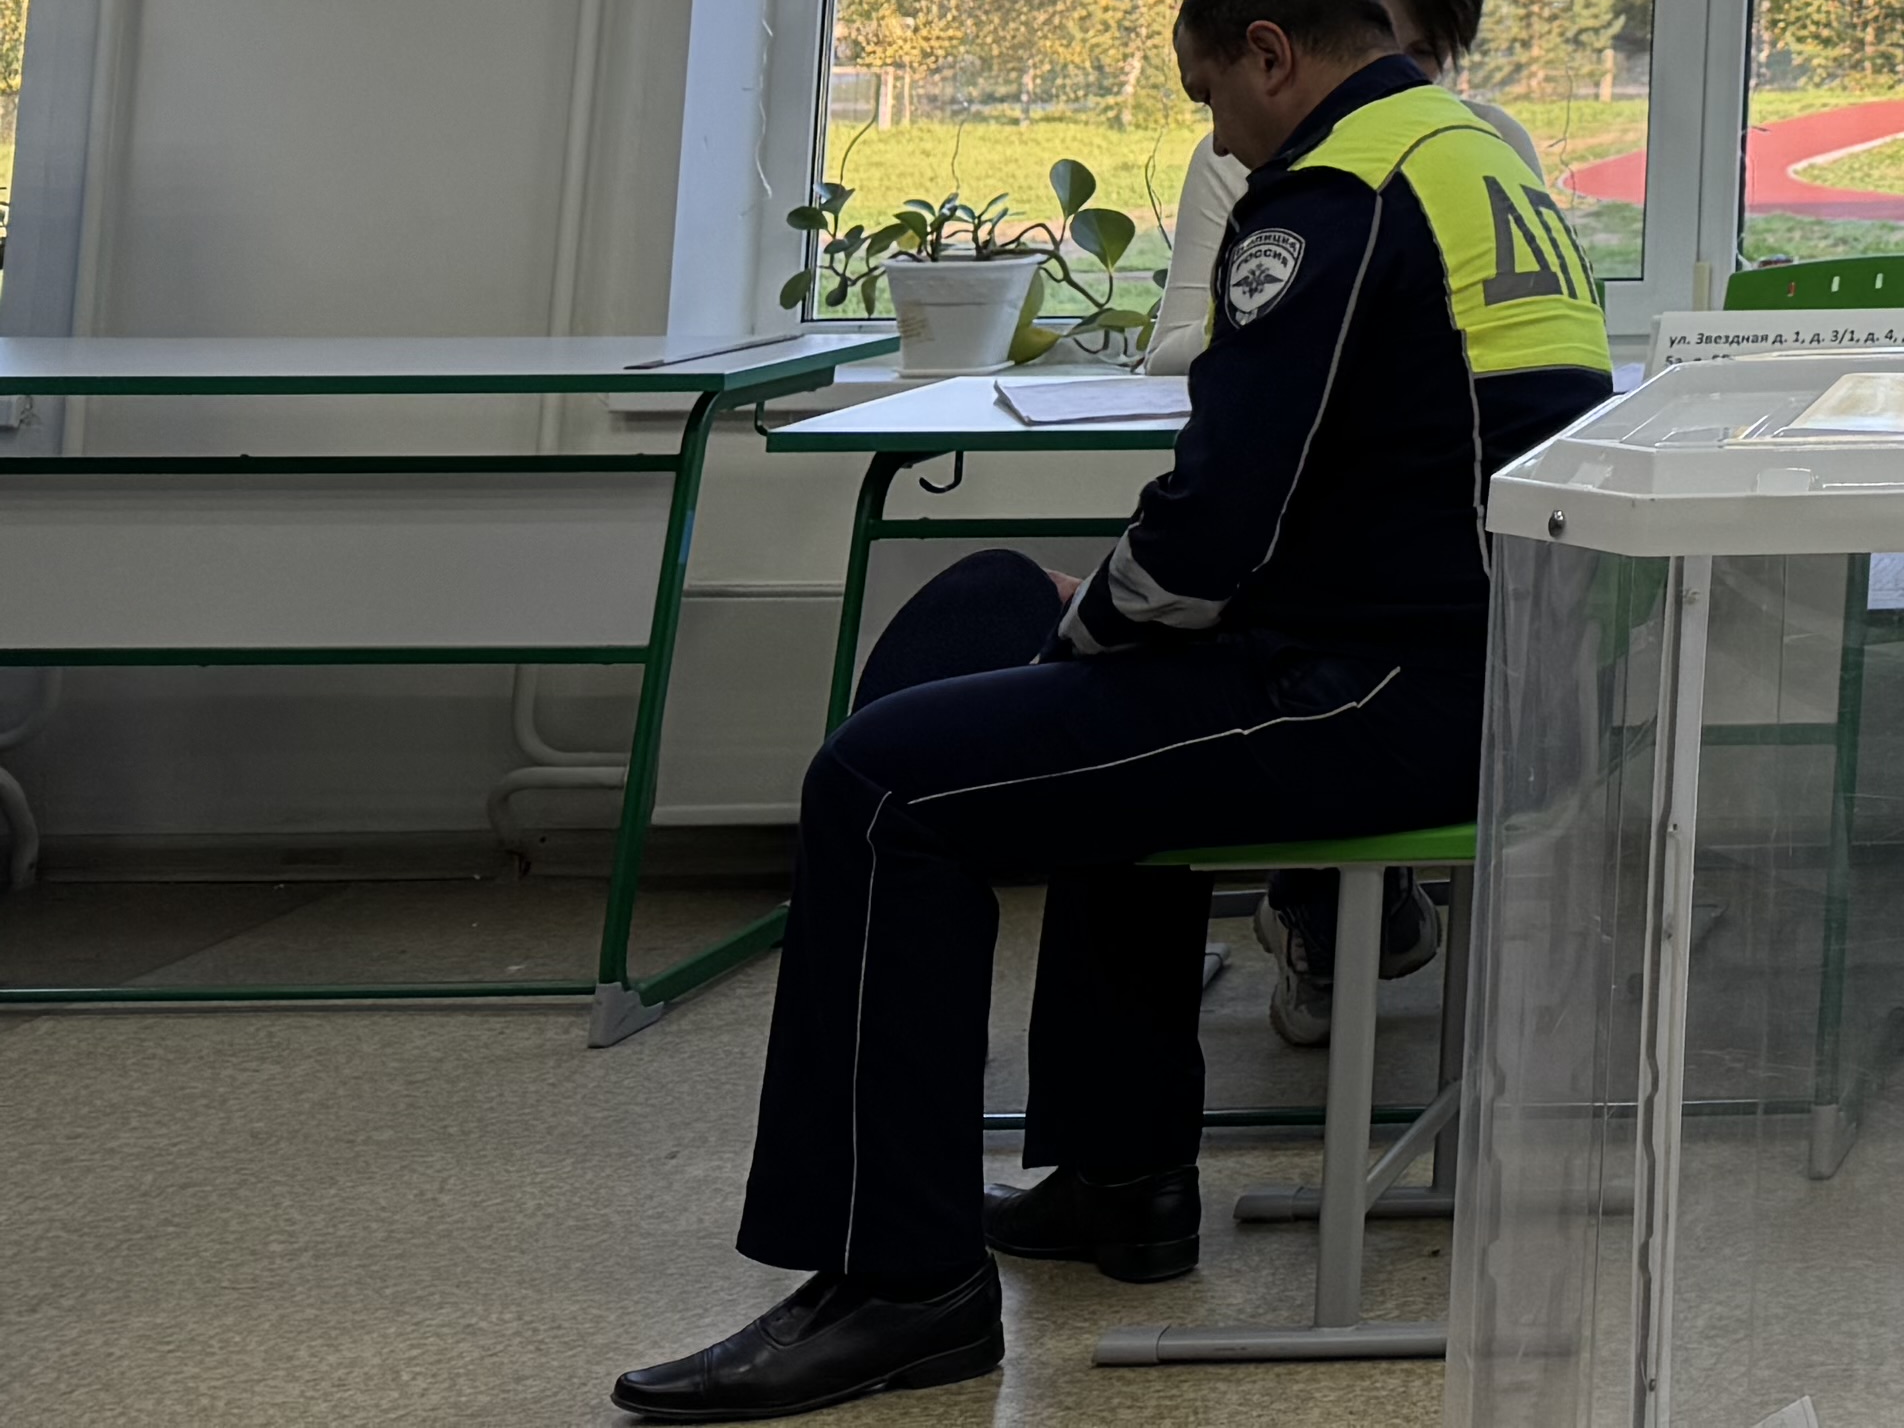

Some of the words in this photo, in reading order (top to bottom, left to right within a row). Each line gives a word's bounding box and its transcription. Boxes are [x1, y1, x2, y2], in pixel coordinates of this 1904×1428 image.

[1669, 335, 1690, 348] ул.
[1696, 333, 1768, 345] Звездная
[1771, 333, 1788, 345] д.
[1793, 331, 1805, 345] 1,
[1809, 332, 1825, 344] д.
[1830, 328, 1860, 344] 3/1,
[1864, 332, 1880, 344] д.
[1884, 329, 1898, 344] 4,
